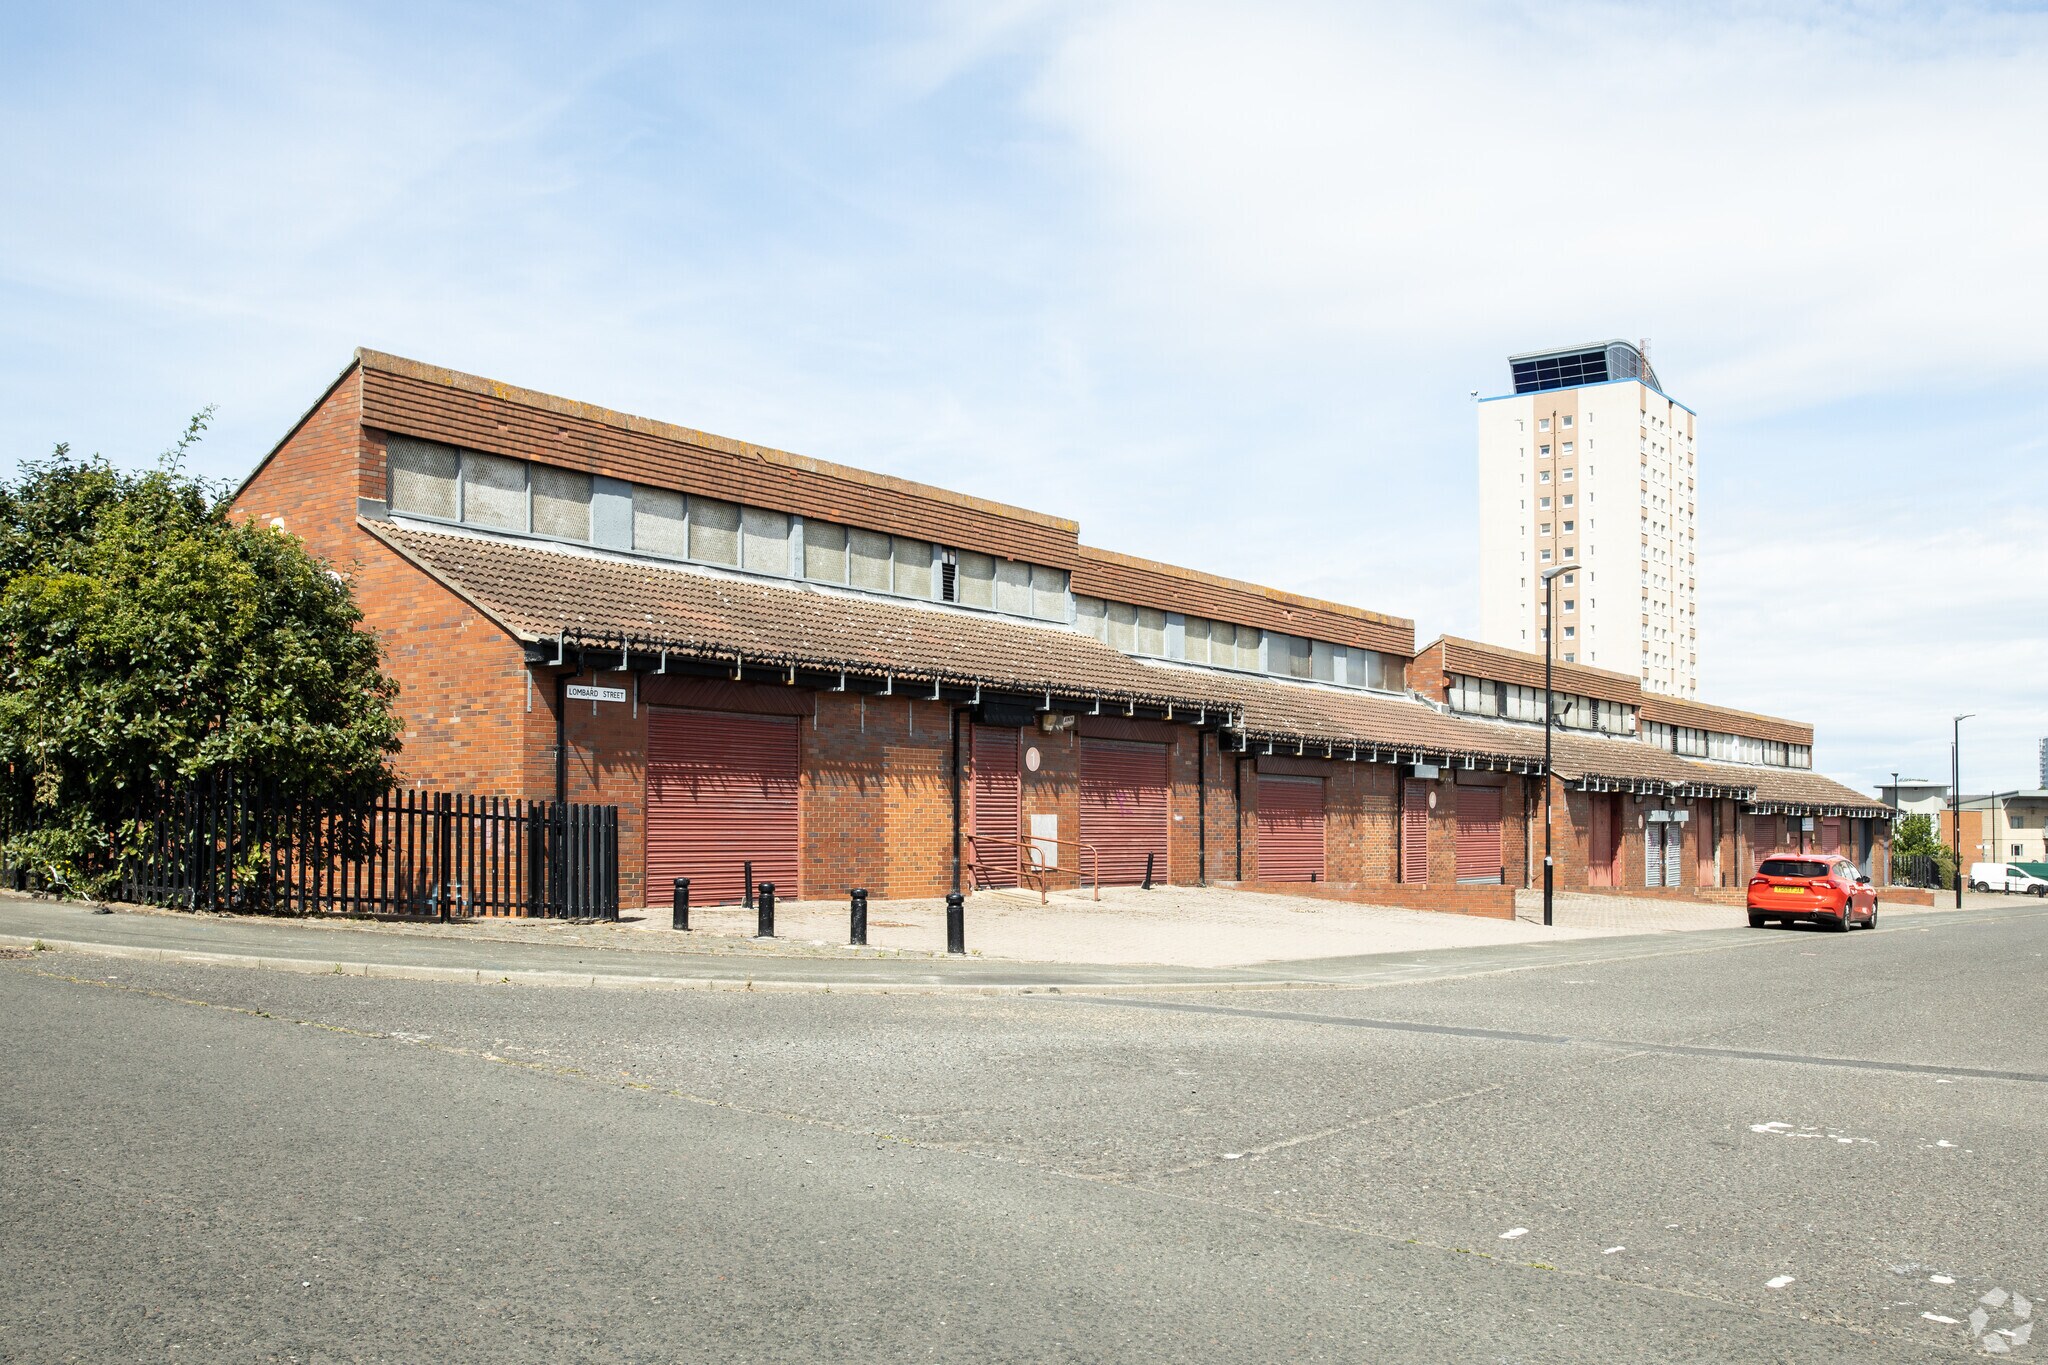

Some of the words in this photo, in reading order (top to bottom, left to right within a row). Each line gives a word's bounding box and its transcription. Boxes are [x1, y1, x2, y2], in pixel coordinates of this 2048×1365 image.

[569, 688, 598, 697] LOMBARD
[603, 691, 624, 699] STREET
[1030, 752, 1035, 767] 1
